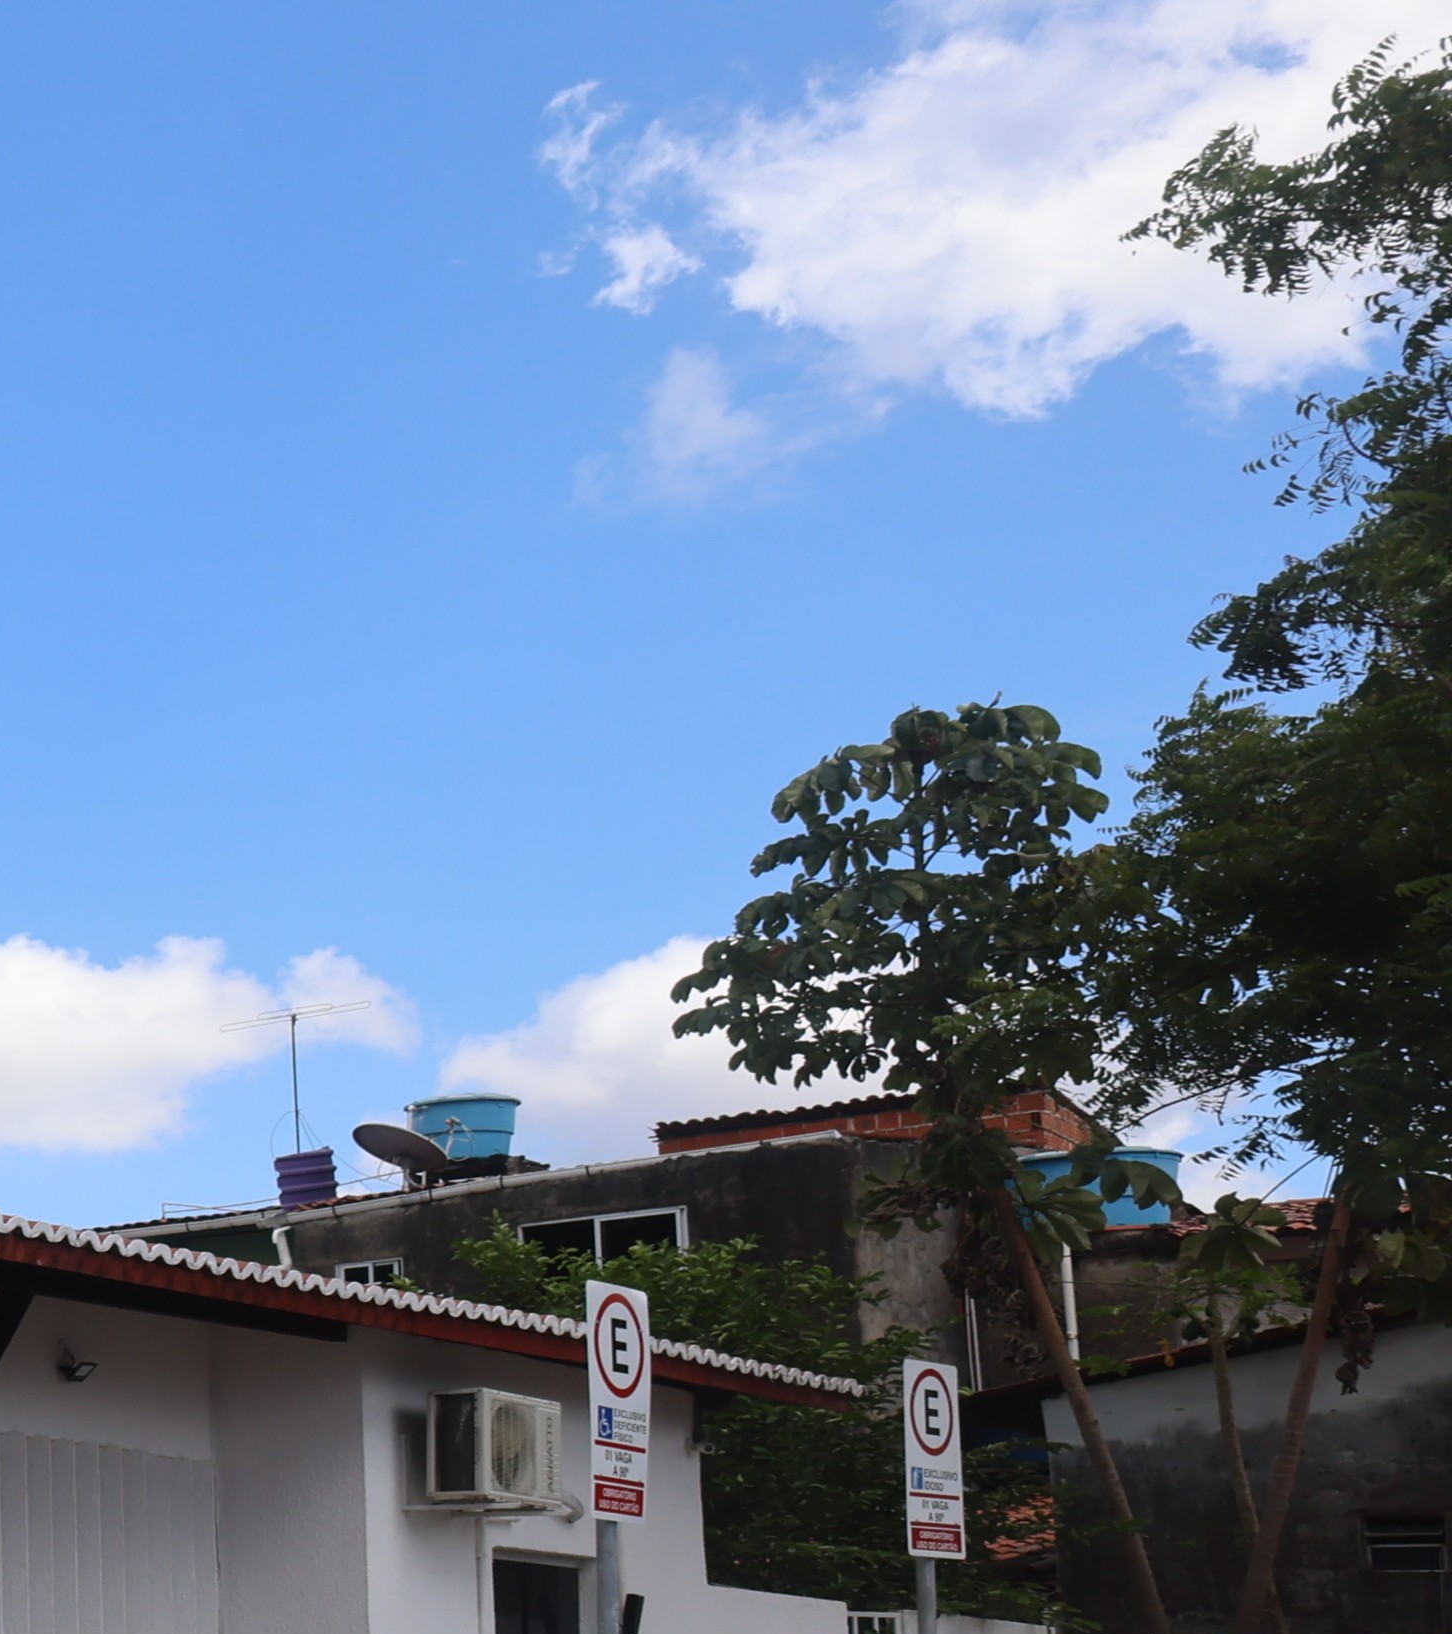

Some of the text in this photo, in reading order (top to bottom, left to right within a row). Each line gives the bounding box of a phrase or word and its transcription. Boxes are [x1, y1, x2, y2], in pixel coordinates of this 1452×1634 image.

[611, 1317, 629, 1375] E
[614, 1408, 646, 1422] EXCLUSIVO
[924, 1389, 941, 1436] E
[614, 1420, 647, 1435] DEFICIENTE
[615, 1450, 632, 1463] VAGA
[924, 1468, 958, 1482] EXCLUSIVO
[924, 1481, 944, 1492] IDOSO
[931, 1500, 949, 1511] VAGA
